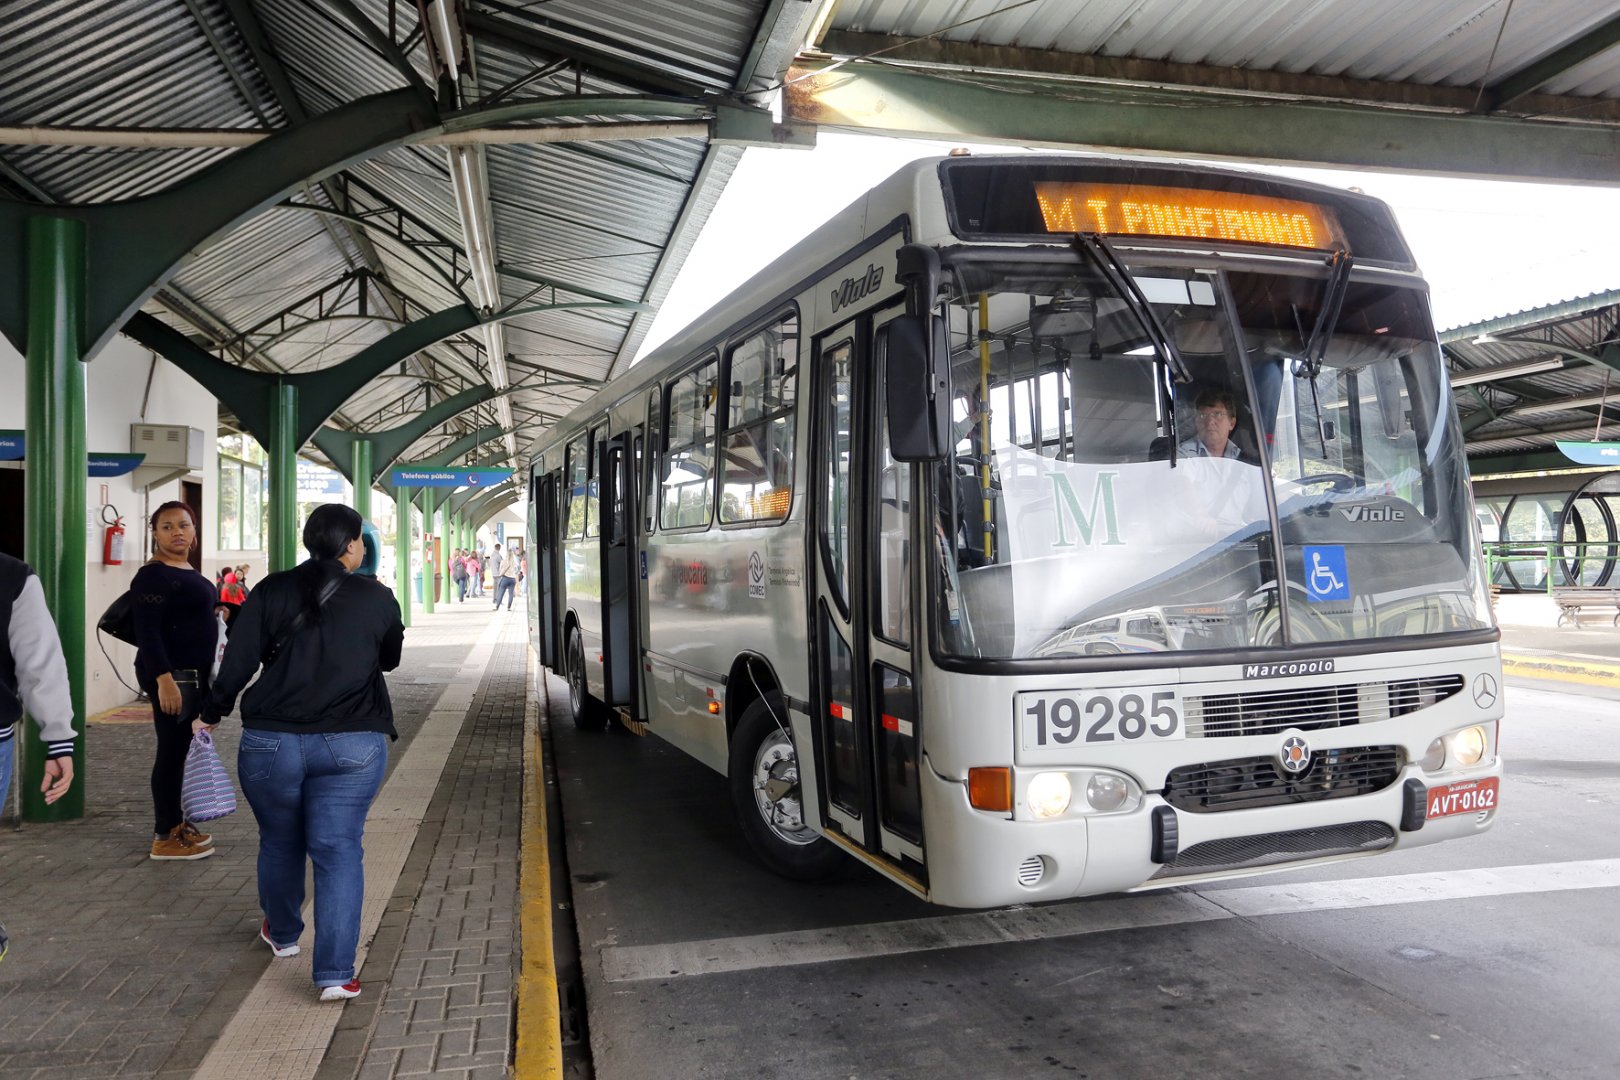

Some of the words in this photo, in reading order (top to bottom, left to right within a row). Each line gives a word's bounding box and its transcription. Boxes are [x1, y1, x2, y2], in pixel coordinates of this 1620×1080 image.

[1037, 196, 1075, 231] M
[1121, 202, 1316, 247] PINHEIRINHO
[831, 264, 884, 313] Viale
[1045, 470, 1127, 547] M
[1339, 505, 1405, 522] Viale
[749, 584, 765, 596] COMEC
[1246, 660, 1332, 678] Marcopolo
[1026, 691, 1178, 746] 19285
